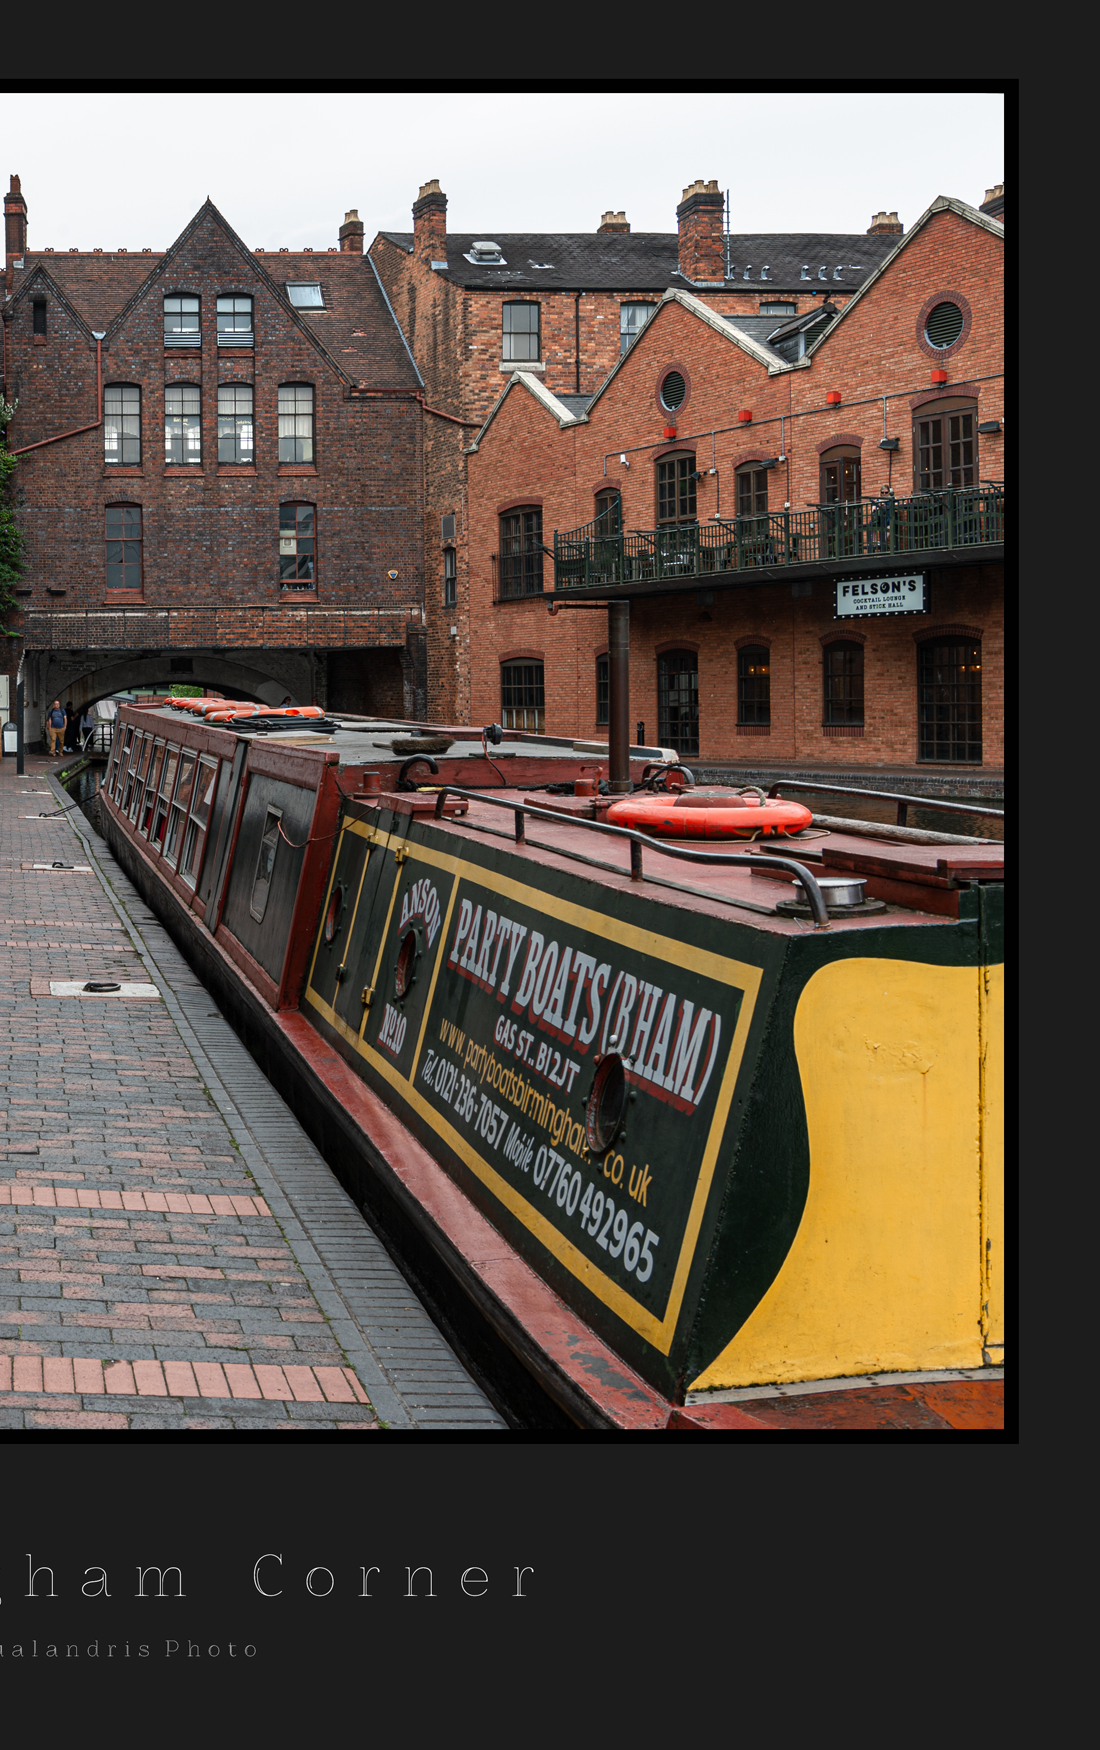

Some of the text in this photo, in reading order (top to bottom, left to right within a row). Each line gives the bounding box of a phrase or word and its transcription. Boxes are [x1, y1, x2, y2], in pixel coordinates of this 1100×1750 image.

[842, 579, 917, 597] FELSON'S
[400, 878, 442, 950] ANSON
[449, 898, 722, 1106] PARTY BOATS (B'HAM)
[495, 1014, 518, 1050] GAS
[533, 1144, 582, 1216] 07760
[579, 1182, 660, 1283] 492965
[628, 1164, 653, 1208] uk
